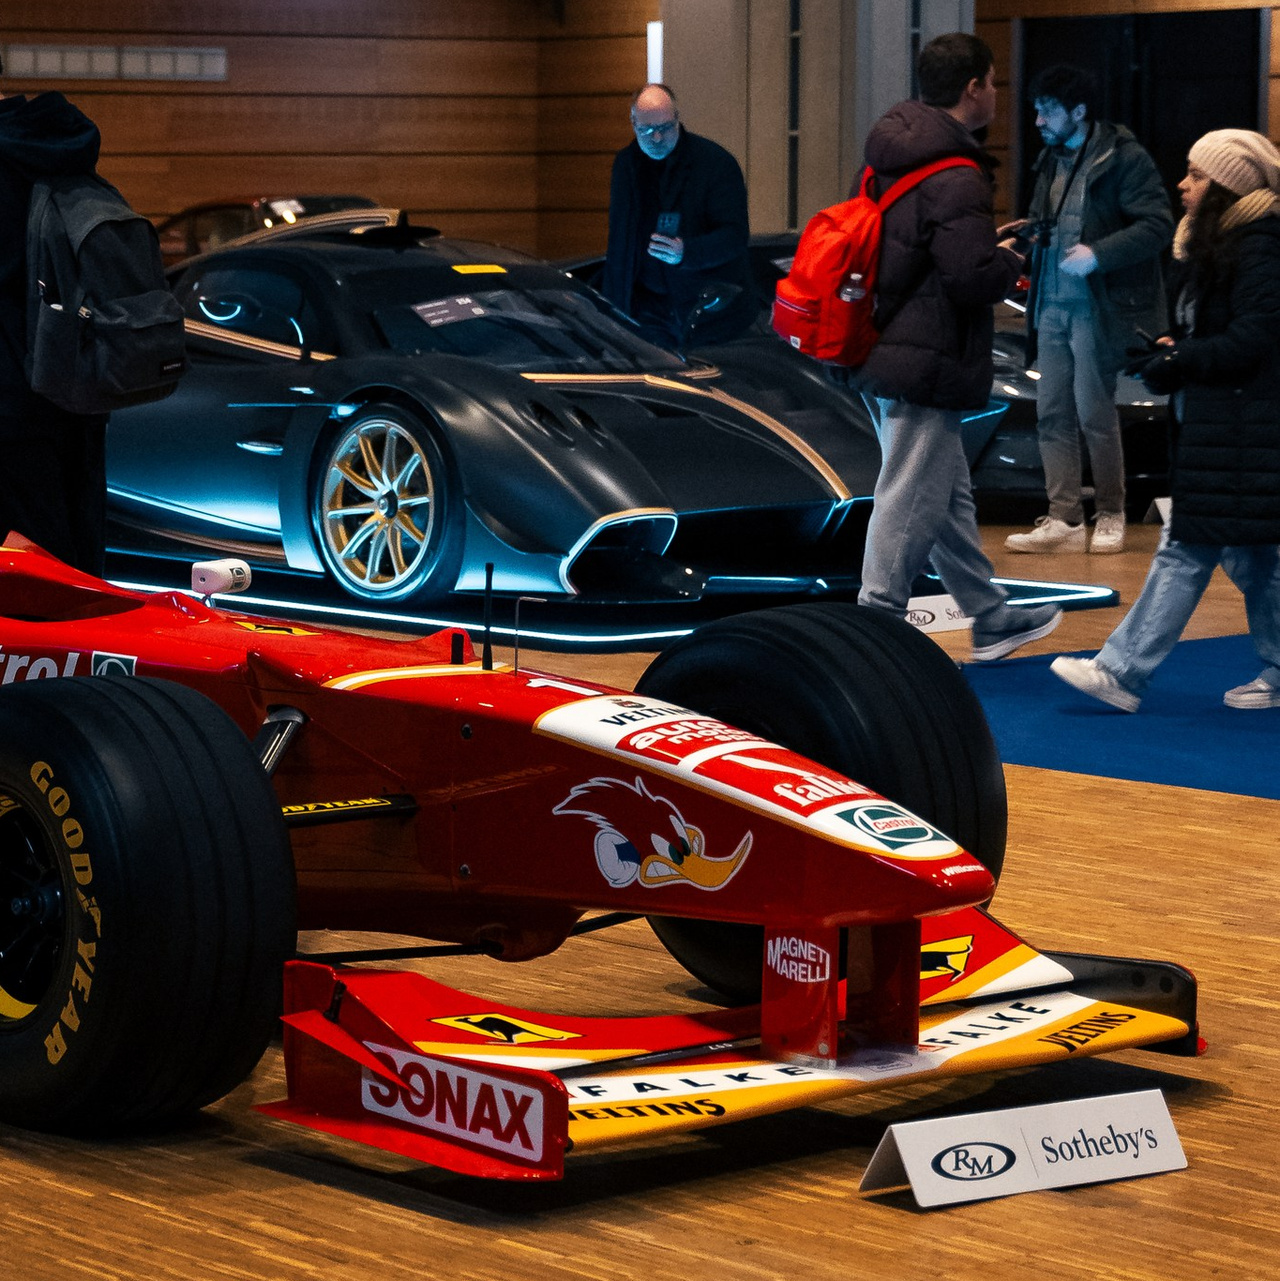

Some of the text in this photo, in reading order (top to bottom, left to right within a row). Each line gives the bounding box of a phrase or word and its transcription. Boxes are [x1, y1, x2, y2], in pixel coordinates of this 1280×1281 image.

[629, 721, 729, 750] auto
[872, 817, 918, 832] Castrol
[30, 760, 102, 1065] GOODYEAR
[767, 936, 830, 967] MAGNETI
[923, 1002, 1052, 1046] FALKE
[1036, 1011, 1137, 1053] VELTINS
[369, 1051, 535, 1151] SONAX
[577, 1066, 814, 1097] FALKE
[952, 1124, 1158, 1176] RM Sotheby's
